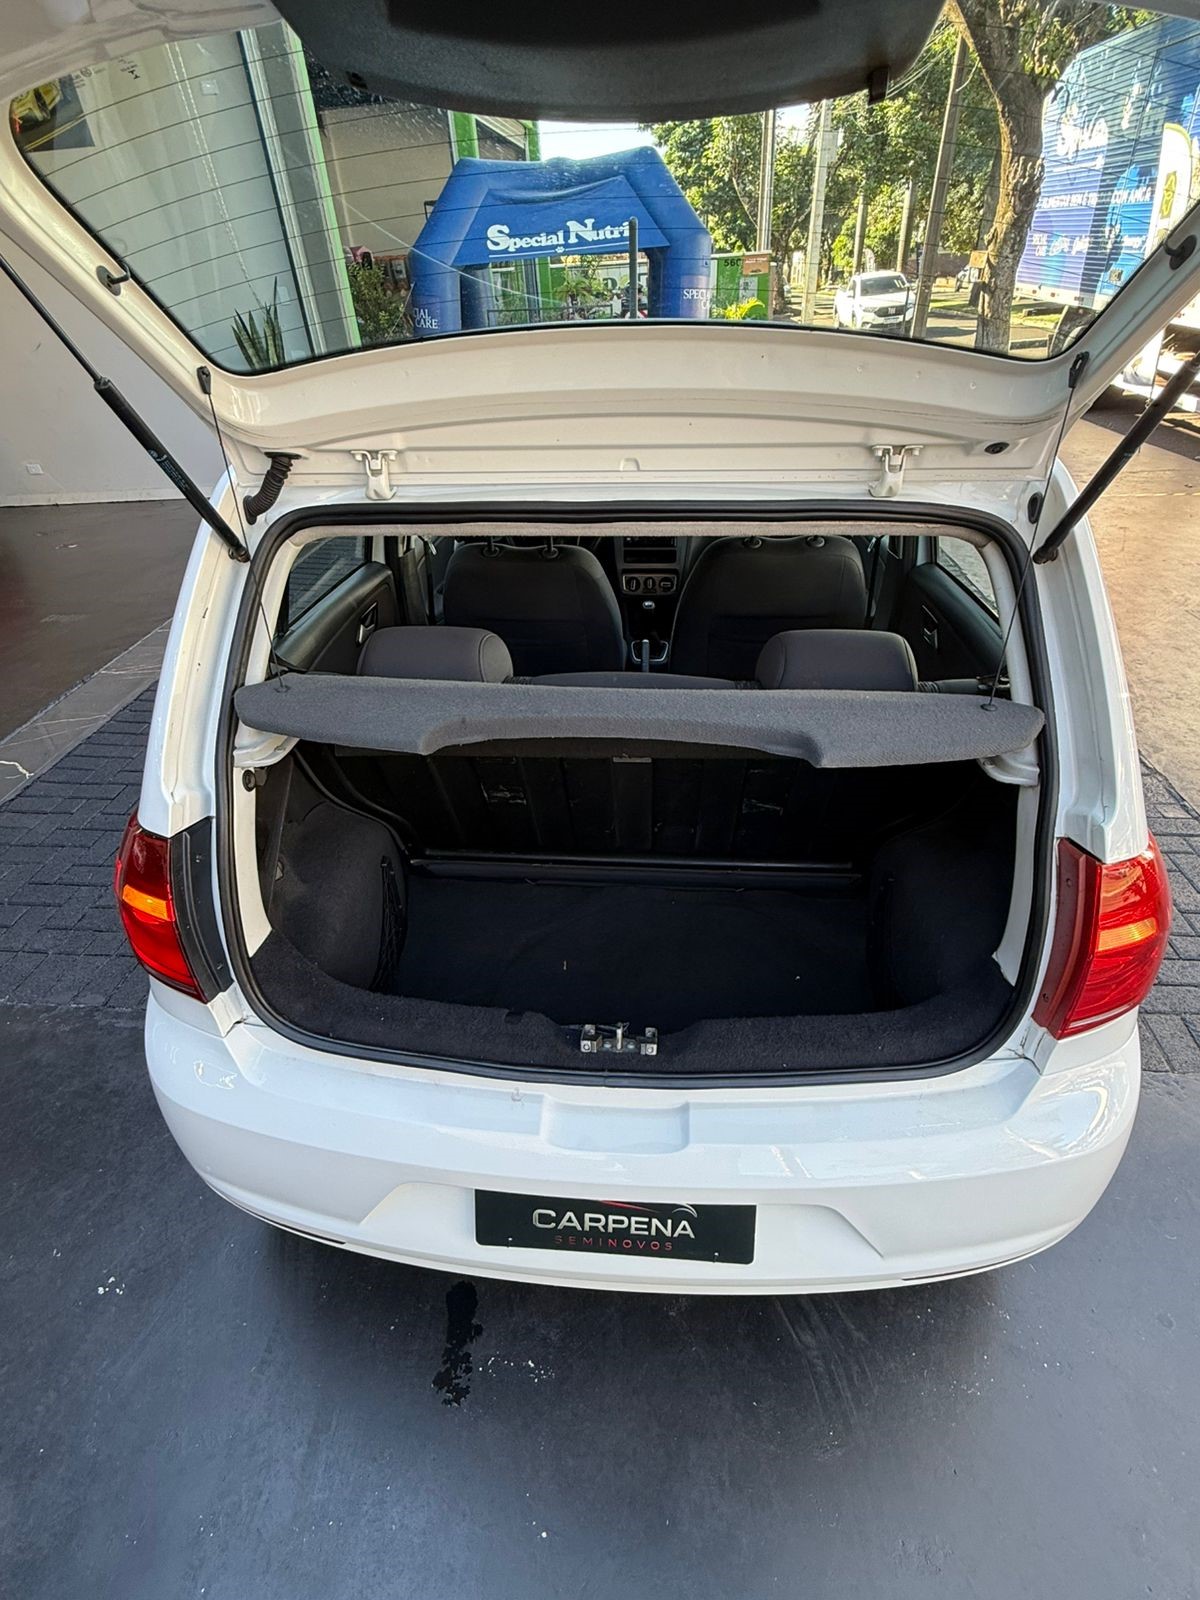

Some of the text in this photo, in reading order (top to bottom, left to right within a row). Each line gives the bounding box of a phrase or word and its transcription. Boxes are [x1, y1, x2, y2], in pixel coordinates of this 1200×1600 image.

[486, 218, 630, 252] Special Nutri
[415, 319, 439, 329] CARE
[532, 1208, 696, 1239] CARPENA
[554, 1235, 673, 1250] SEMINOVOS
